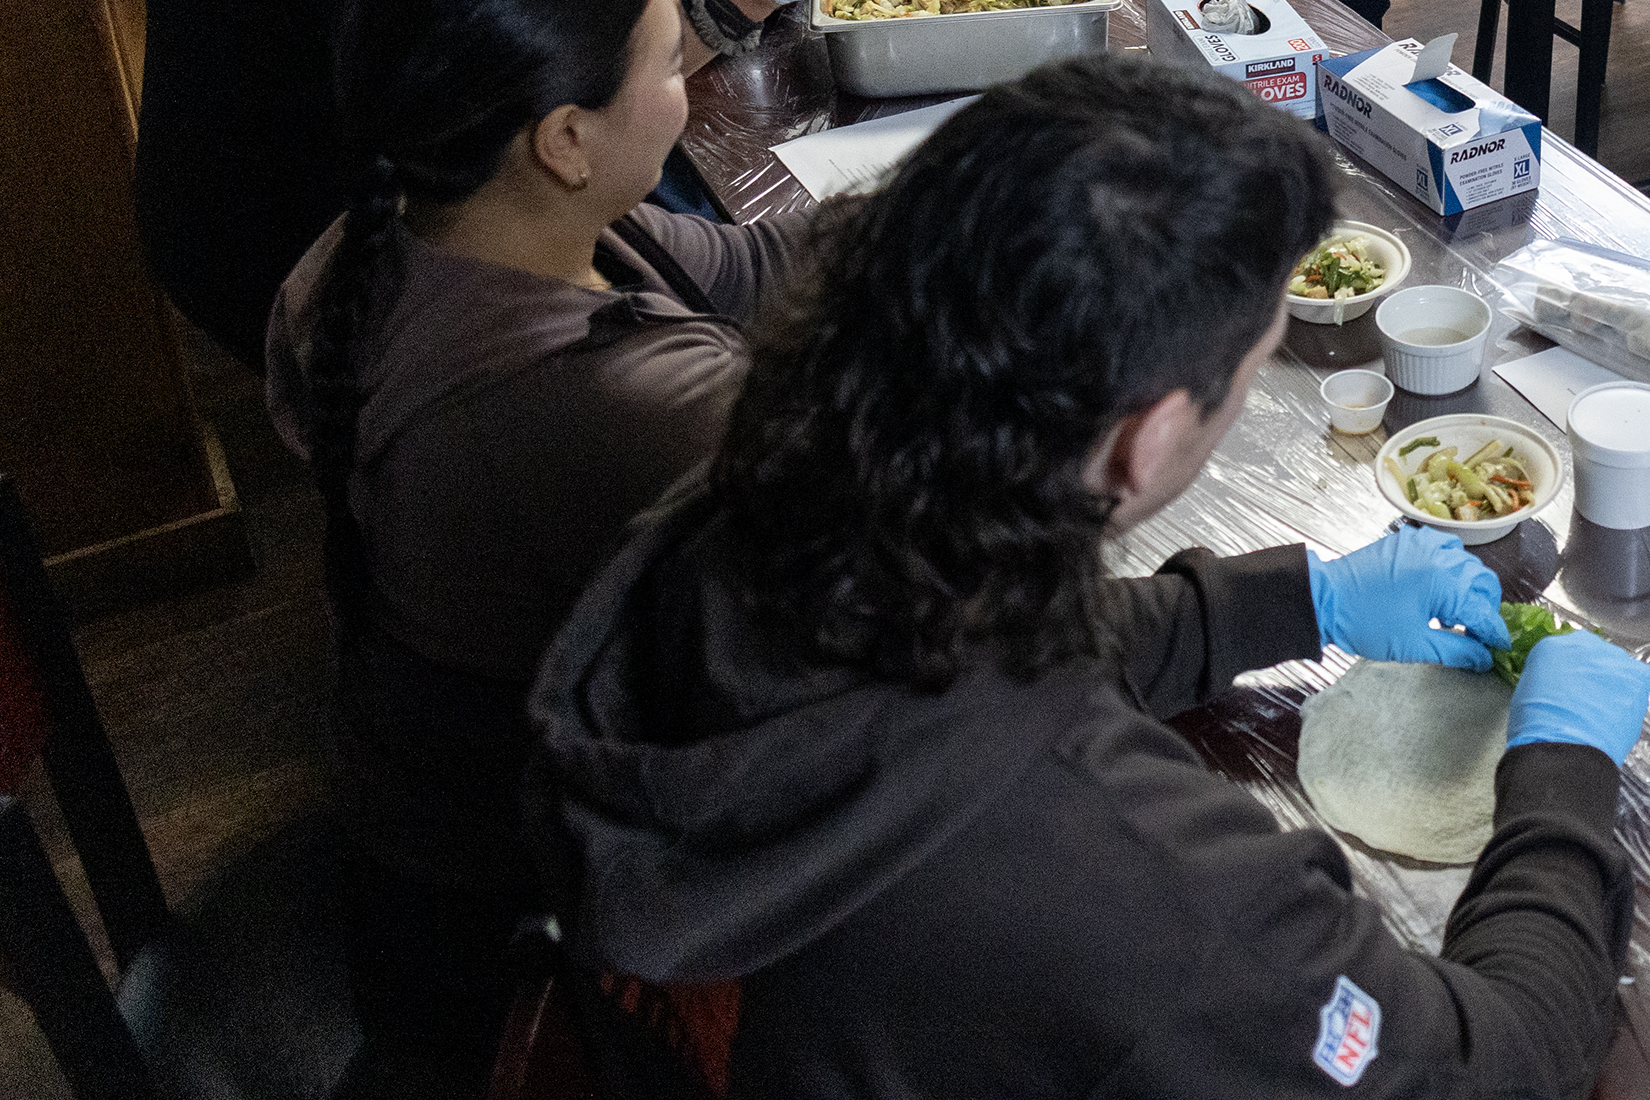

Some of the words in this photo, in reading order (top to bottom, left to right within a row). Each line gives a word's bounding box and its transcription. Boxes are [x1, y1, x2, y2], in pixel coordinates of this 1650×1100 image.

[1205, 34, 1236, 62] GLOVES
[1291, 39, 1309, 51] 200
[1248, 59, 1294, 73] KIRKLAND
[1244, 78, 1275, 91] ITRILE
[1277, 75, 1300, 86] EXAM
[1261, 82, 1305, 101] OVES
[1323, 74, 1373, 119] RADNOR
[1450, 139, 1506, 164] RADNOR
[1488, 163, 1504, 172] NITRILE
[1514, 161, 1529, 177] XL
[1460, 174, 1487, 187] EXAMINATION
[1487, 169, 1503, 179] GLOVES
[1517, 175, 1532, 184] GLOVES
[1337, 1010, 1371, 1070] NFL
